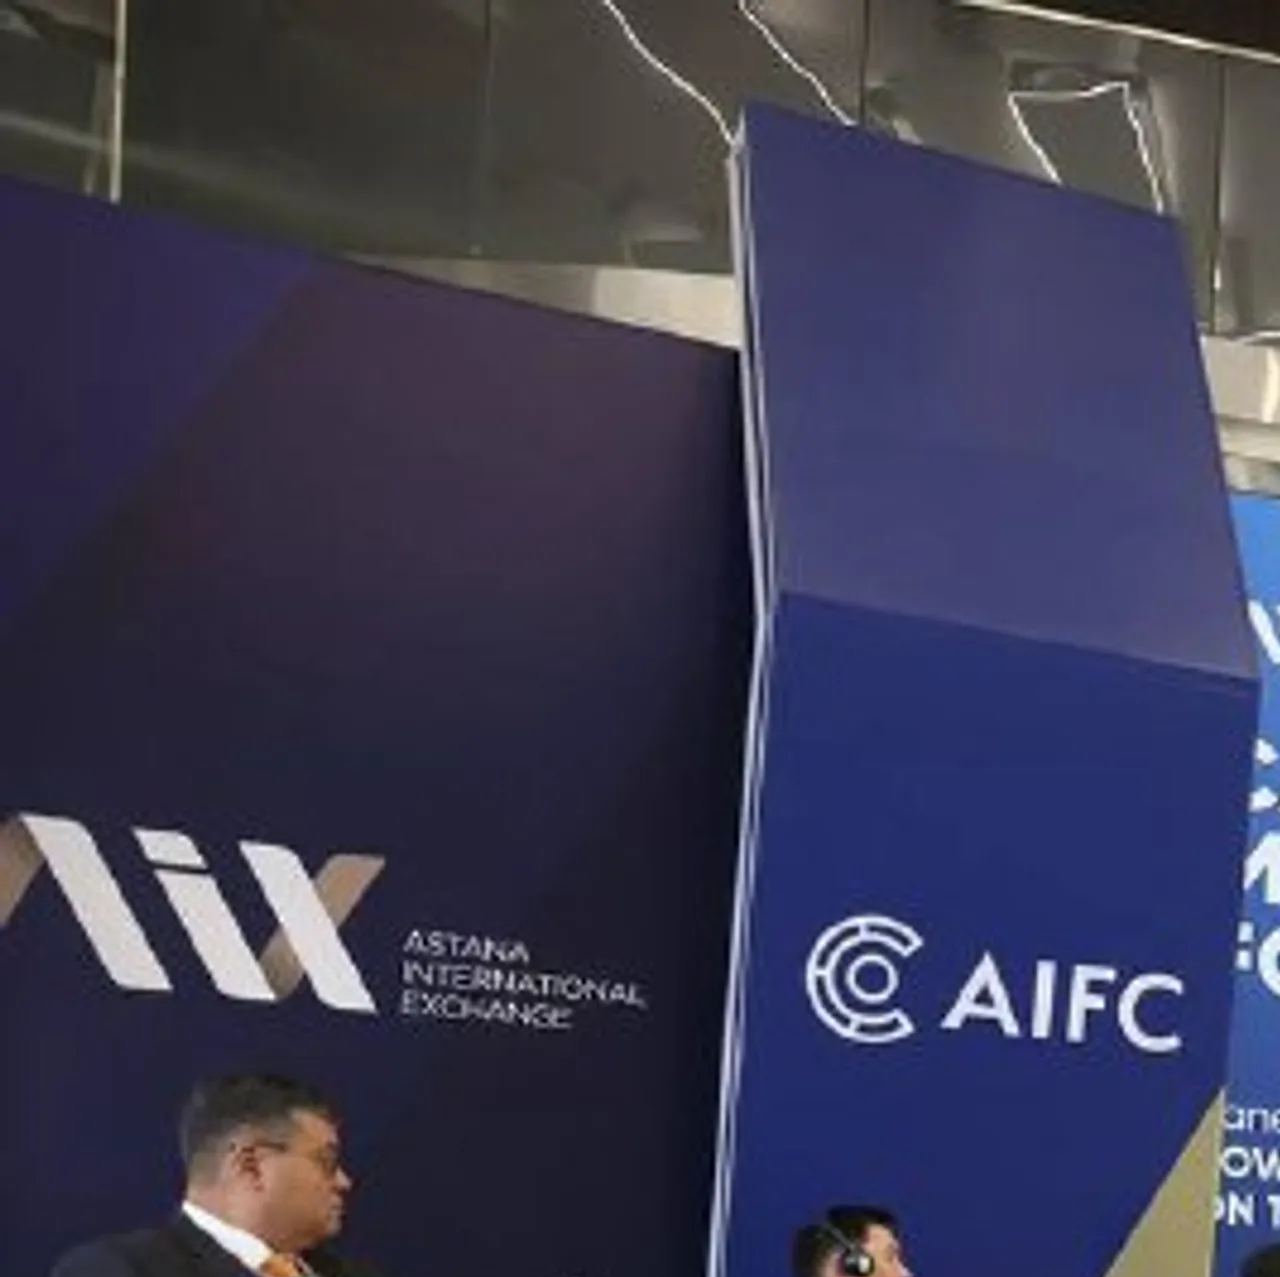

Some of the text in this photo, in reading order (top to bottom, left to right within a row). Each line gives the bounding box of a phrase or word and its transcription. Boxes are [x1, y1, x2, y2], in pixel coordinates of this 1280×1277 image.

[402, 929, 531, 966] ASTANA
[402, 959, 649, 1010] INTERNATIONAL
[940, 950, 1185, 1054] AIFC
[402, 988, 574, 1029] EXCHANGE
